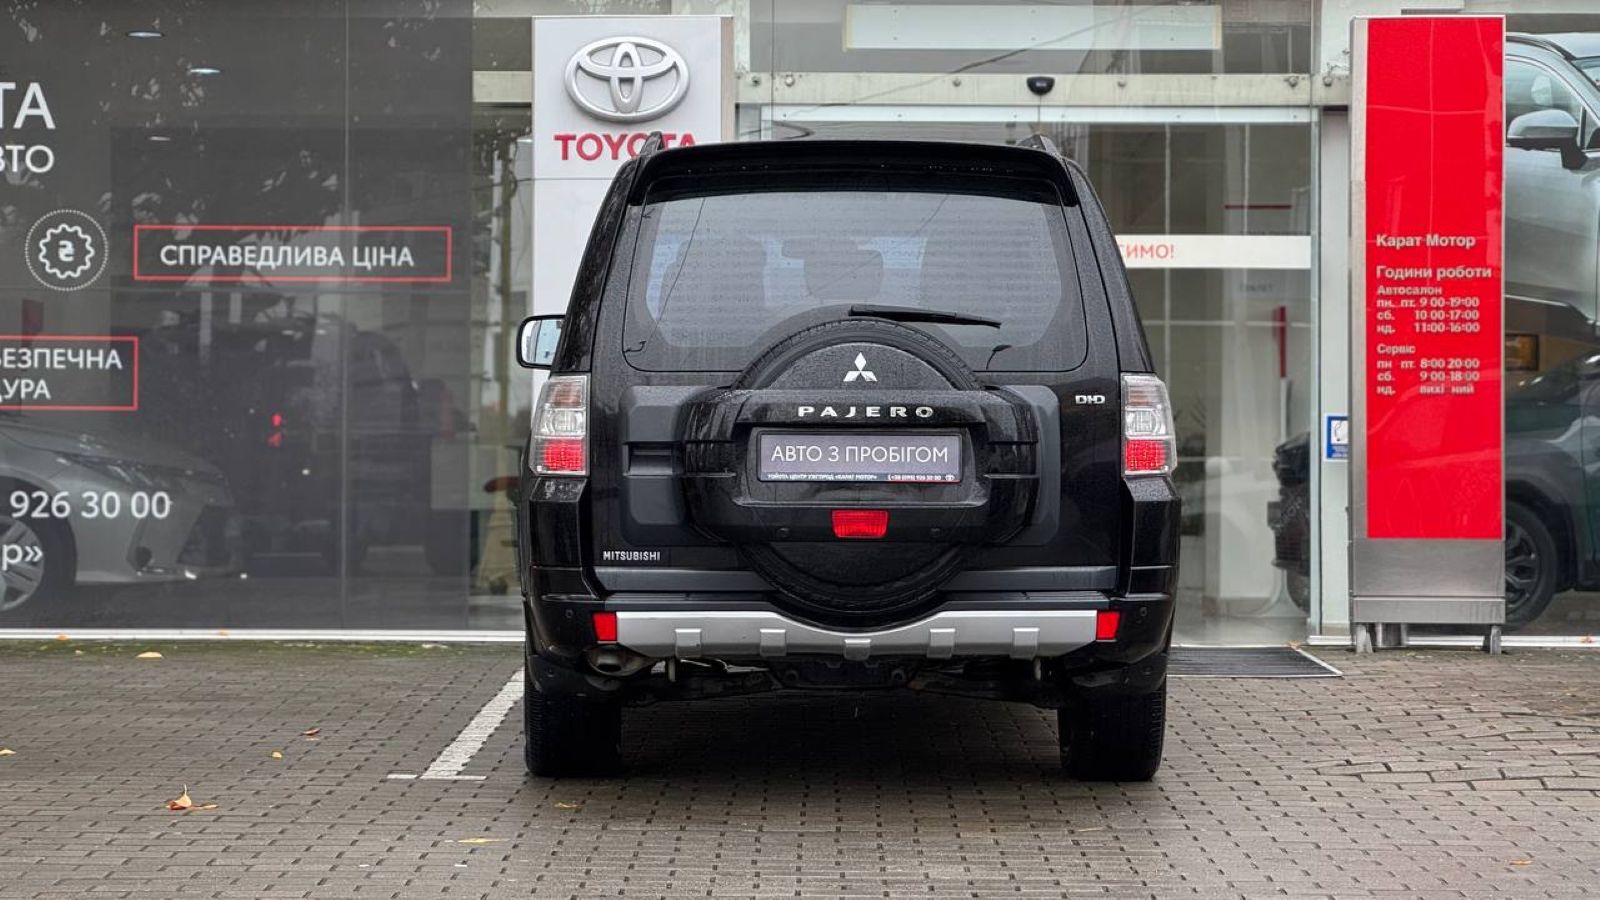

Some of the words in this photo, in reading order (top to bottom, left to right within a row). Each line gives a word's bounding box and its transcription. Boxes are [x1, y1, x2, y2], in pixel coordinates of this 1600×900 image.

[1376, 234, 1422, 250] Карат
[1426, 234, 1476, 249] Мотор
[160, 245, 345, 269] СПРАВЕДЛИВА
[352, 246, 415, 271] ЦІНА
[1376, 266, 1432, 280] Години
[1437, 266, 1492, 281] роботи
[1376, 285, 1442, 295] Автосалон
[1376, 344, 1416, 355] Сервіс
[0, 348, 123, 369] ЕЗПЕЧНА
[0, 379, 51, 400] УРА
[797, 405, 934, 418] PAJERO
[770, 445, 823, 462] АВТО
[845, 446, 948, 463] ПРОБІГОМ
[10, 491, 71, 518] 926
[81, 491, 121, 518] 30
[130, 491, 171, 518] 00
[602, 550, 661, 561] MITSUBISHI
